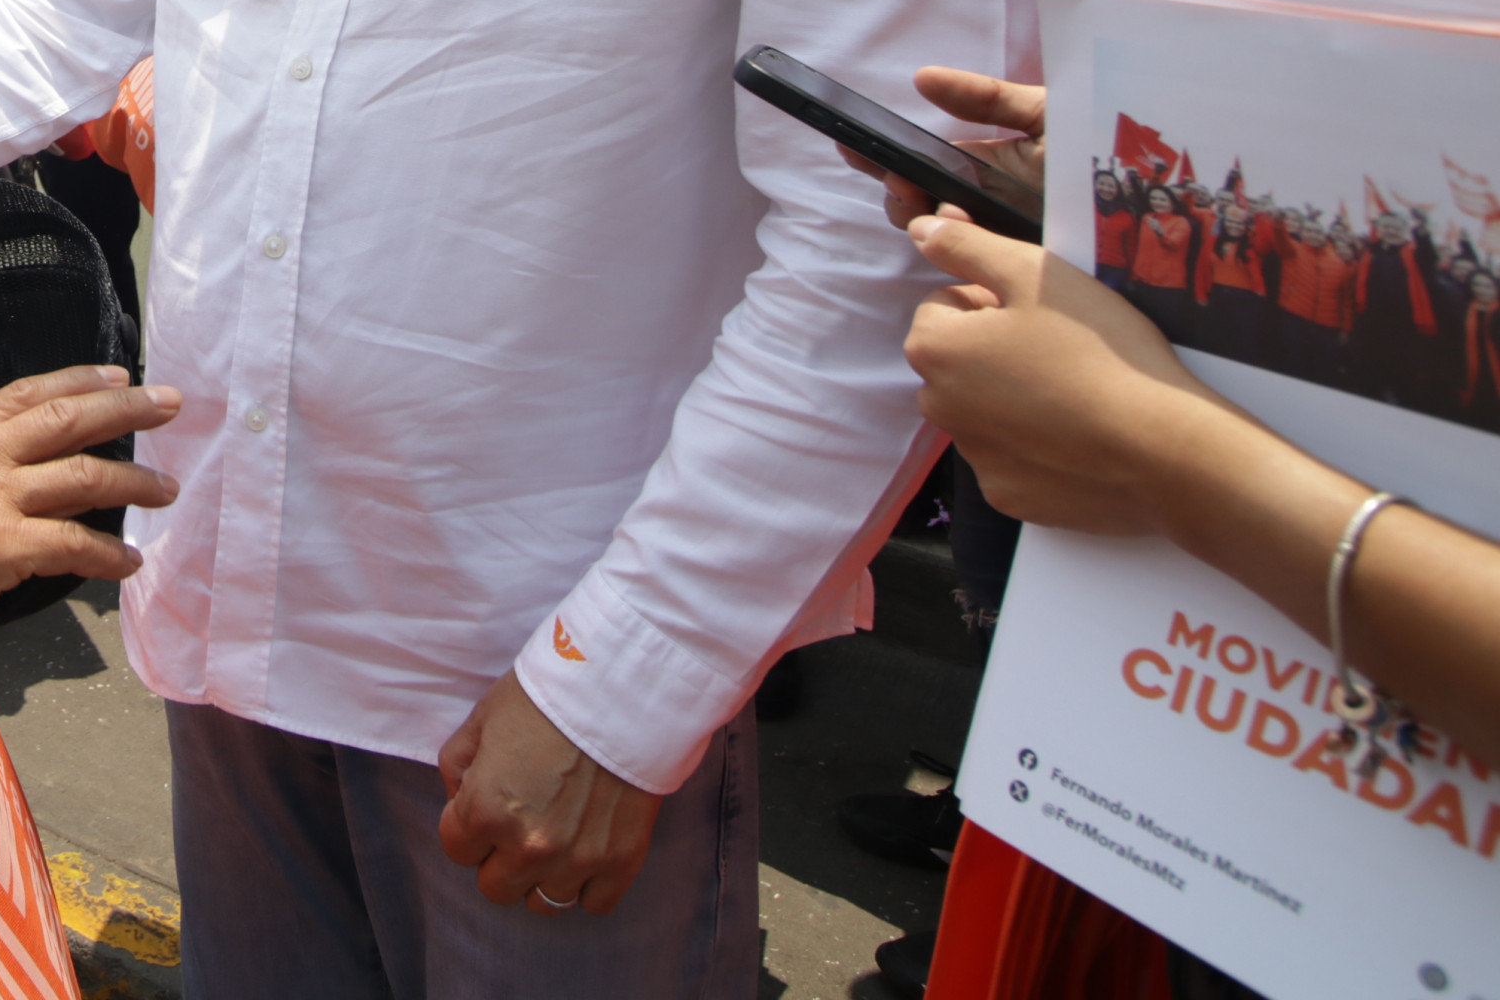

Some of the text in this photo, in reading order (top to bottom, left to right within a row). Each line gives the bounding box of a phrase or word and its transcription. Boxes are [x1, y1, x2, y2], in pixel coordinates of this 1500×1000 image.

[1041, 801, 1187, 892] @FerMoralesMtz
[1050, 767, 1132, 821] Fernando
[1135, 813, 1209, 864] Morales
